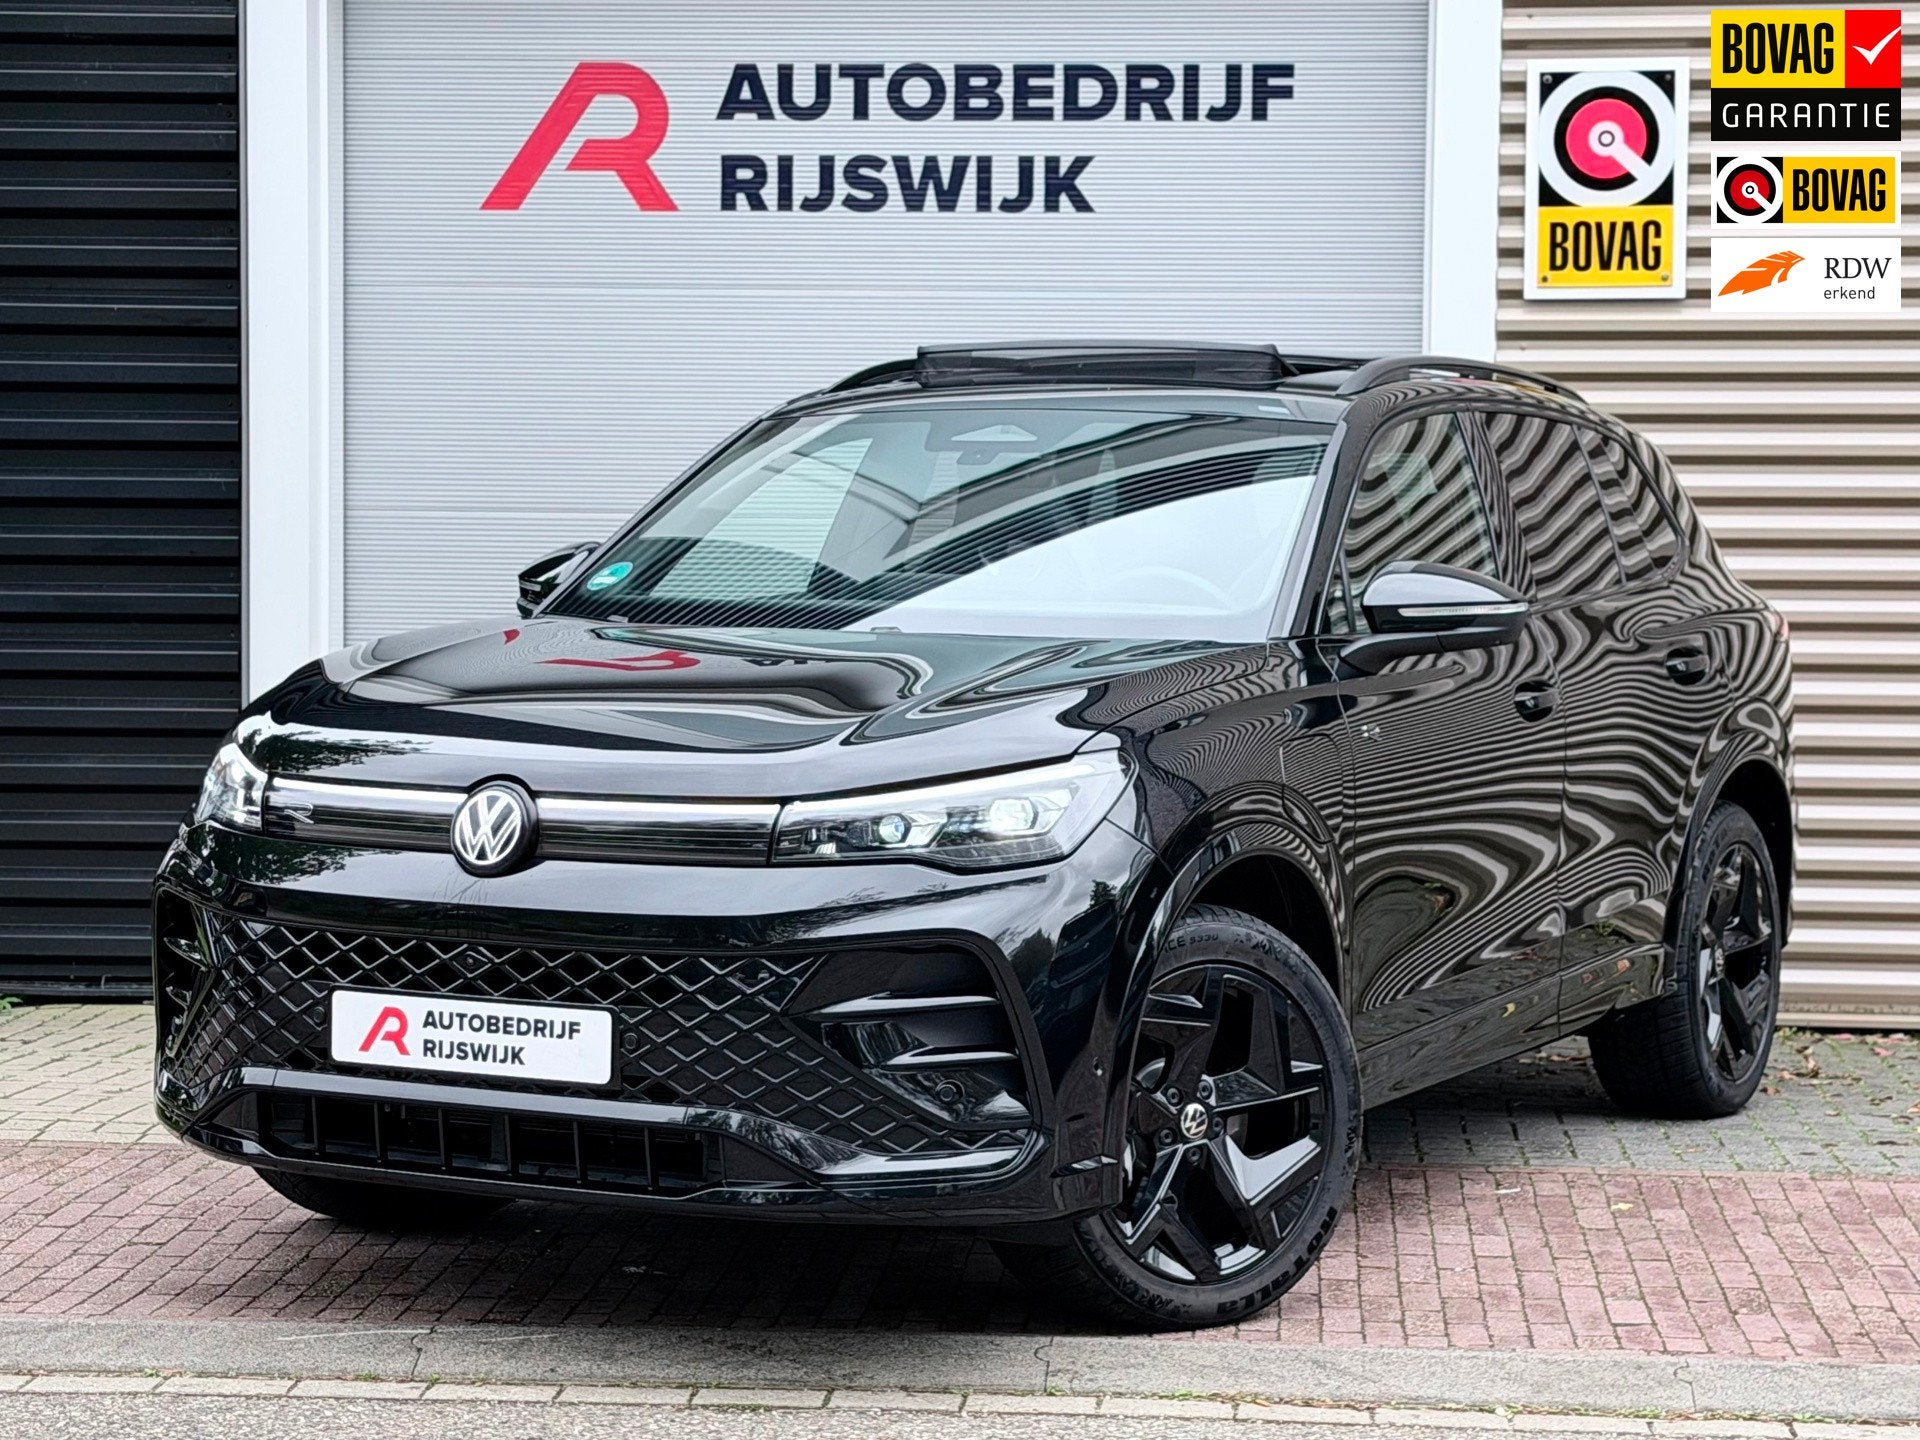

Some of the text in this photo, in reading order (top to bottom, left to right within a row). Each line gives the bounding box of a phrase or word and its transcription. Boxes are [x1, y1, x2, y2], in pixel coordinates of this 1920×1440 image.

[716, 63, 1295, 122] AUTOBEDRIJF
[720, 154, 1095, 213] RIJSWIJK
[1549, 220, 1662, 272] BOVAG
[422, 1010, 581, 1040] AUTOBEDRIJF
[423, 1038, 526, 1065] RIJSWIJK
